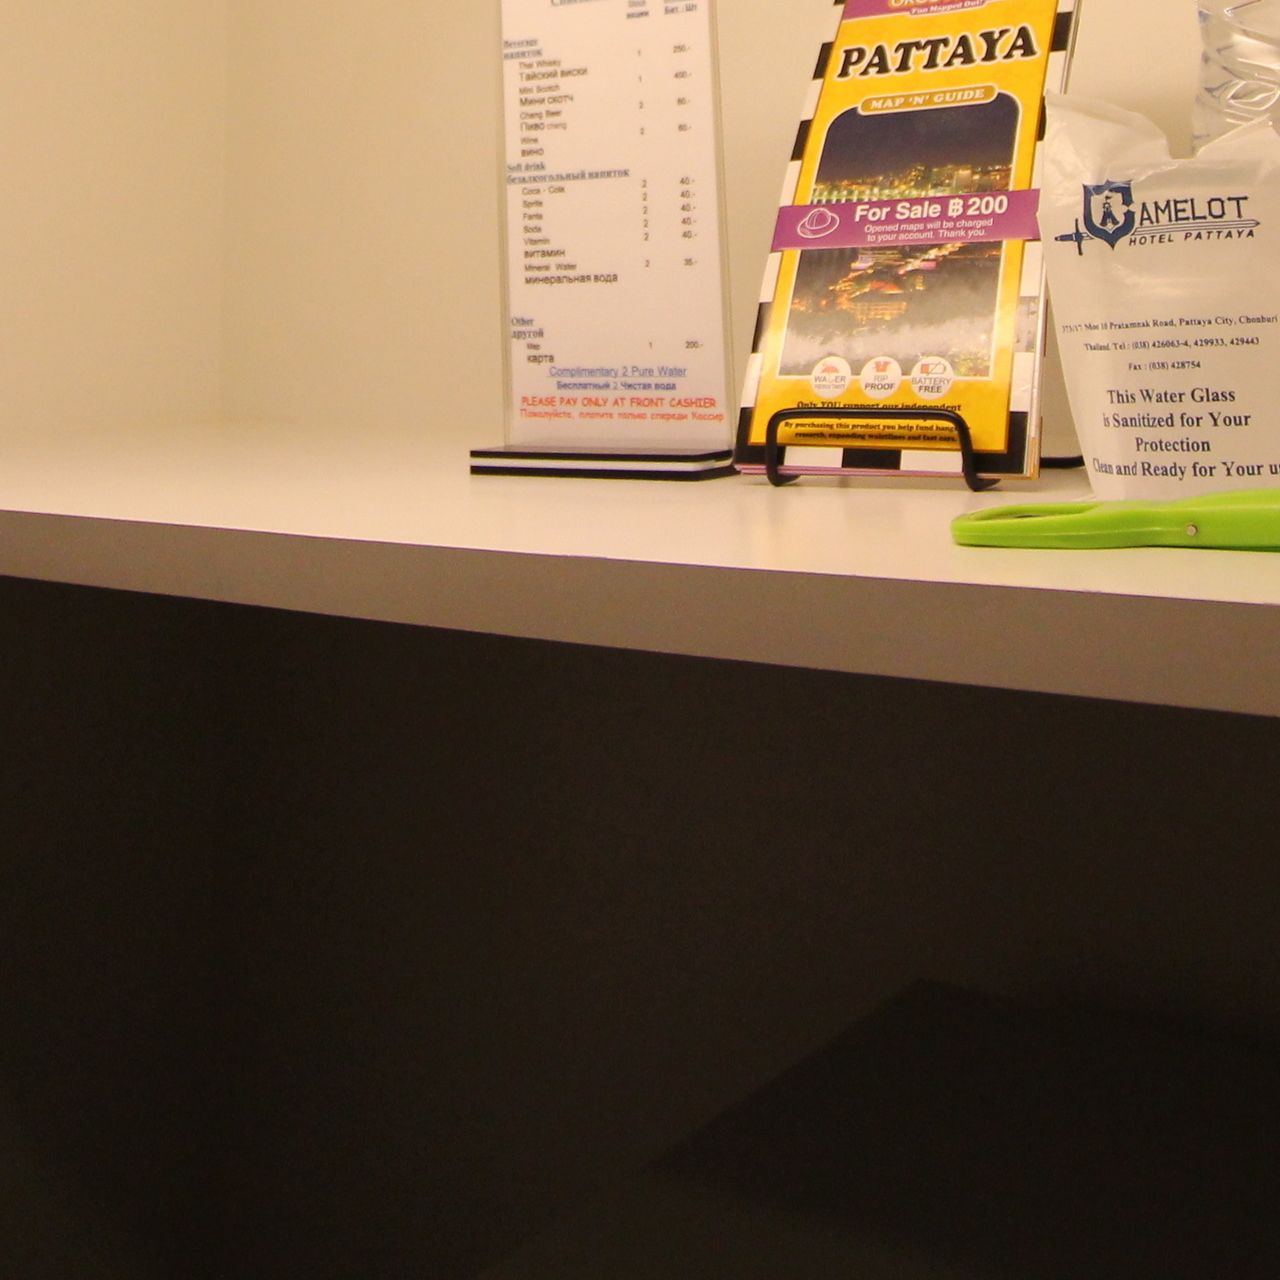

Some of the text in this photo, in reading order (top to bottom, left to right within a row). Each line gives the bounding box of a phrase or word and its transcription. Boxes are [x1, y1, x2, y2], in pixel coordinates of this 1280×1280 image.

[836, 25, 1038, 79] PATTAYA
[870, 88, 985, 110] MAP 'N' GUIDE
[854, 204, 891, 223] For
[895, 200, 942, 220] Sale
[966, 195, 1009, 216] 200
[864, 217, 993, 235] Opened maps will be charged
[867, 233, 877, 242] to
[878, 233, 897, 244] your
[899, 230, 934, 241] account.
[938, 228, 966, 239] Thank
[1129, 229, 1255, 246] HOTEL PATTAYA
[524, 249, 566, 258] витамин
[525, 273, 618, 286] минеральная вода
[511, 317, 534, 327] Other
[1109, 320, 1151, 331] Pratamnak
[1153, 318, 1177, 329] Road,
[1179, 317, 1213, 329] Pattaya
[1215, 316, 1237, 327] City,
[1238, 314, 1278, 325] Chonburi
[511, 328, 544, 340] другой
[1112, 341, 1127, 351] Tel
[1132, 340, 1150, 351] (038)
[1152, 338, 1191, 349] 426063-4,
[1193, 337, 1228, 348] 429933,
[1230, 336, 1260, 347] 429443
[527, 353, 555, 364] карта
[1128, 362, 1142, 372] Fax
[1149, 360, 1170, 372] (038)
[1171, 359, 1201, 370] 428754
[549, 366, 687, 379] Complimentary 2 Pure Water
[814, 375, 846, 384] WAER
[911, 377, 951, 386] BATTERY
[557, 382, 611, 391] Бесплатный
[620, 382, 653, 391] Чистая
[654, 382, 677, 391] вода
[864, 382, 896, 391] PROOF
[917, 384, 943, 394] FREE
[521, 396, 717, 408] PLEASE PAY ONLY AT FRONT CASHIER
[1107, 387, 1236, 404] This Water Glass
[1103, 411, 1251, 428] is Sanitized for Your
[784, 422, 795, 431] By
[795, 422, 834, 431] purchasing
[835, 422, 850, 430] this
[851, 423, 881, 432] product
[882, 424, 896, 432] you
[897, 424, 914, 433] help
[916, 424, 933, 432] fund
[1135, 436, 1211, 453] Protection
[1093, 457, 1113, 475] Clean
[1115, 461, 1138, 477] and
[1141, 461, 1187, 481] Ready
[1192, 461, 1217, 478] for
[1221, 461, 1265, 478] Your
